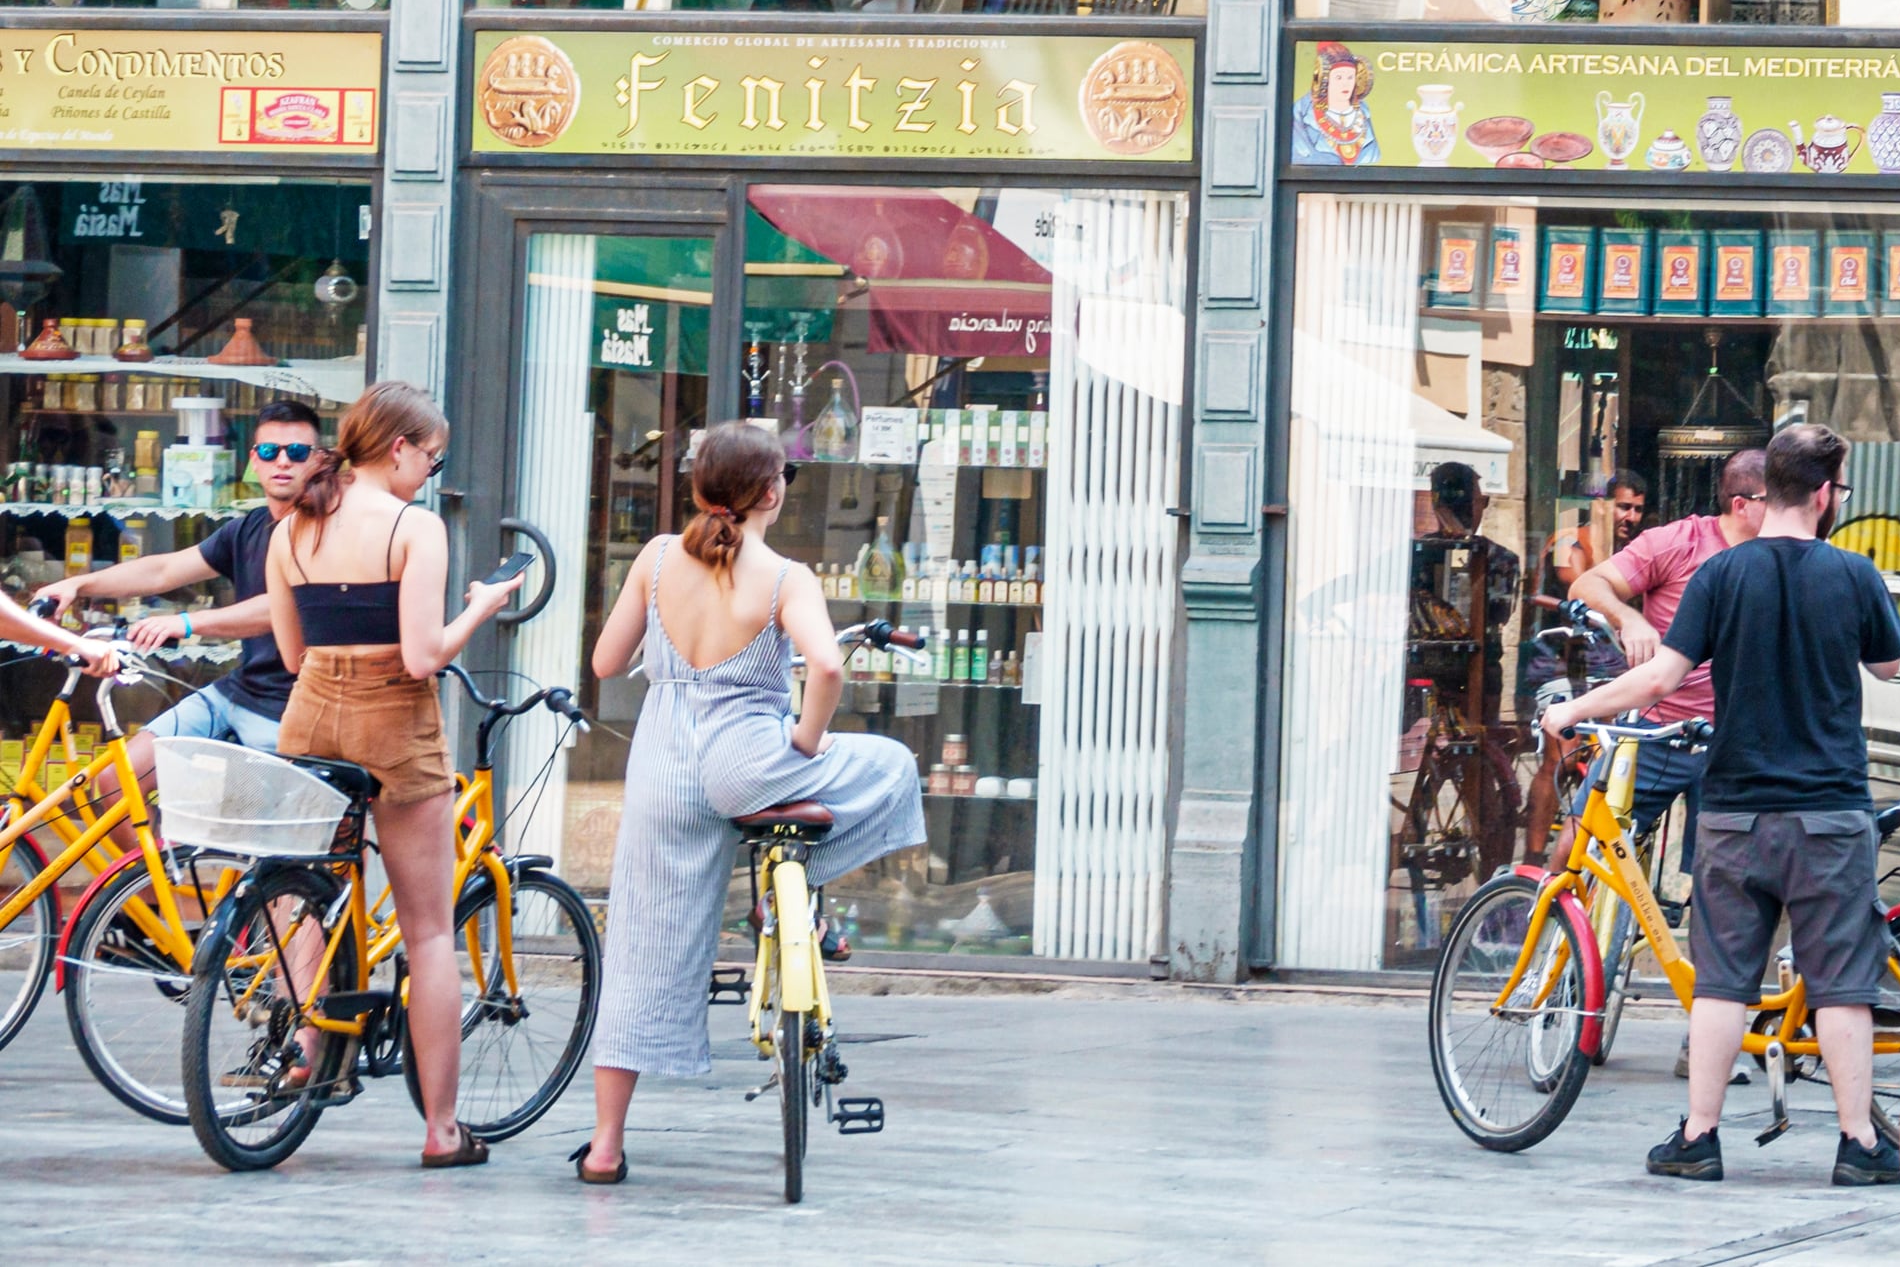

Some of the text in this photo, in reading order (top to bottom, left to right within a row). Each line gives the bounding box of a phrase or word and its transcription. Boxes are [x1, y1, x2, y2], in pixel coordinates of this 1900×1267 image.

[652, 35, 729, 47] COMERCIO
[734, 36, 790, 47] GLOBAL
[796, 37, 815, 47] DE
[908, 38, 1009, 49] TRADICIONAL
[1377, 48, 1524, 73] CERÁMICA
[1527, 54, 1680, 76] ARTESANA
[1686, 56, 1739, 77] DEL
[58, 85, 166, 103] Canela de Ceylan
[615, 48, 1041, 138] Fenitzia
[52, 105, 171, 120] Piñones de Castilla
